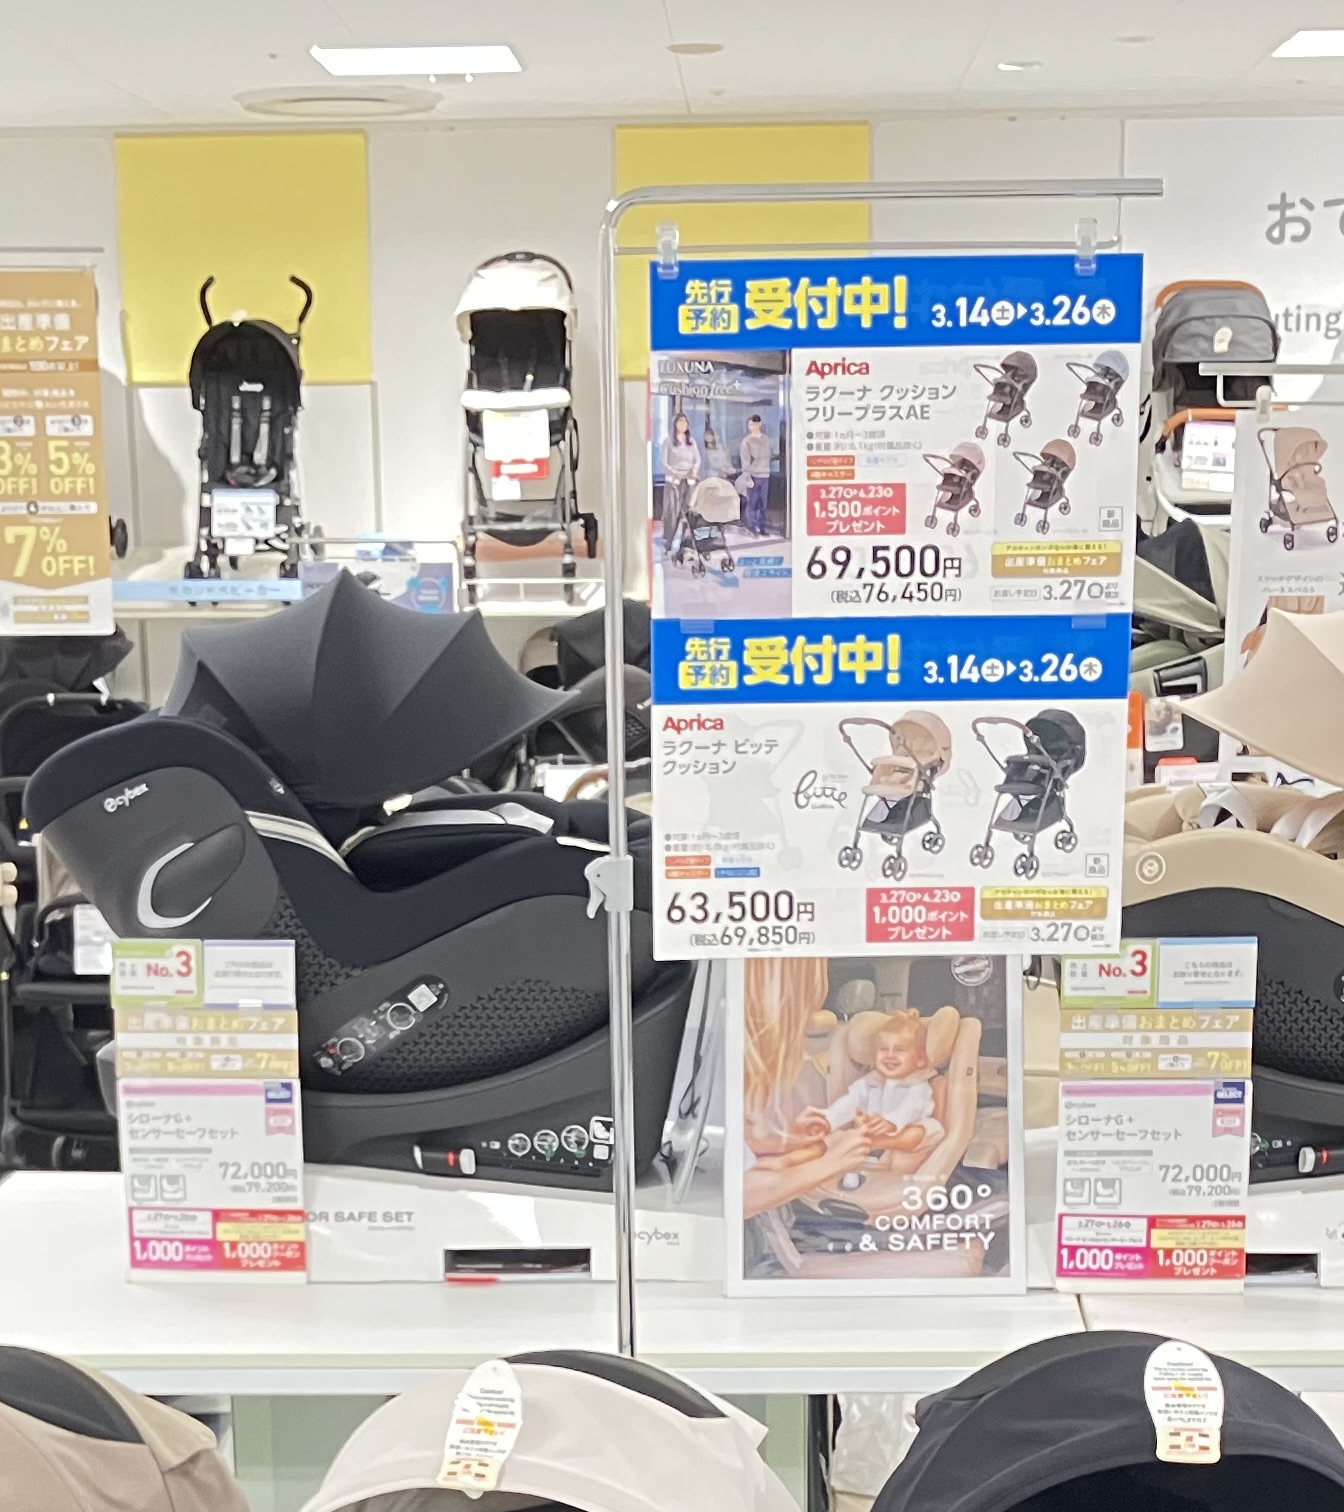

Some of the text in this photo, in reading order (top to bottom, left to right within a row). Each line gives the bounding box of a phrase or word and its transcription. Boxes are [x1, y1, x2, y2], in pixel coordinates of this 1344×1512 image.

[685, 280, 733, 304] 先行
[744, 276, 908, 330] 受付中!
[684, 306, 733, 331] 予約
[806, 359, 870, 379] Aprica
[805, 384, 957, 402] ラクーナ クッション
[806, 404, 931, 423] フリープラスAE
[48, 441, 95, 476] 5%
[50, 477, 95, 495] OFF!
[826, 520, 885, 533] プレゼント
[41, 555, 96, 577] OFF!
[806, 543, 962, 580] 69,500円
[685, 638, 731, 661] 先行
[743, 633, 902, 686] 受付中!
[684, 664, 732, 688] 予約
[662, 714, 725, 735] Aprica
[662, 738, 779, 757] ラクーナ ビッテ
[662, 759, 737, 776] クッション
[666, 888, 815, 924] 63,500円
[887, 924, 952, 941] プレゼント
[1066, 1129, 1182, 1142] センサーセーフセット
[219, 1161, 298, 1180] 72,000円
[1158, 1164, 1242, 1183] 72,000円
[902, 1184, 993, 1211] 360°
[334, 1211, 377, 1224] SAFE
[382, 1211, 414, 1224] SET
[875, 1213, 995, 1232] COMFORT
[134, 1240, 183, 1261] 1,000
[223, 1241, 272, 1259] 1,000
[859, 1231, 995, 1253] & SAFETY
[1060, 1248, 1113, 1270] 1,000
[1157, 1248, 1208, 1267] 1,000
